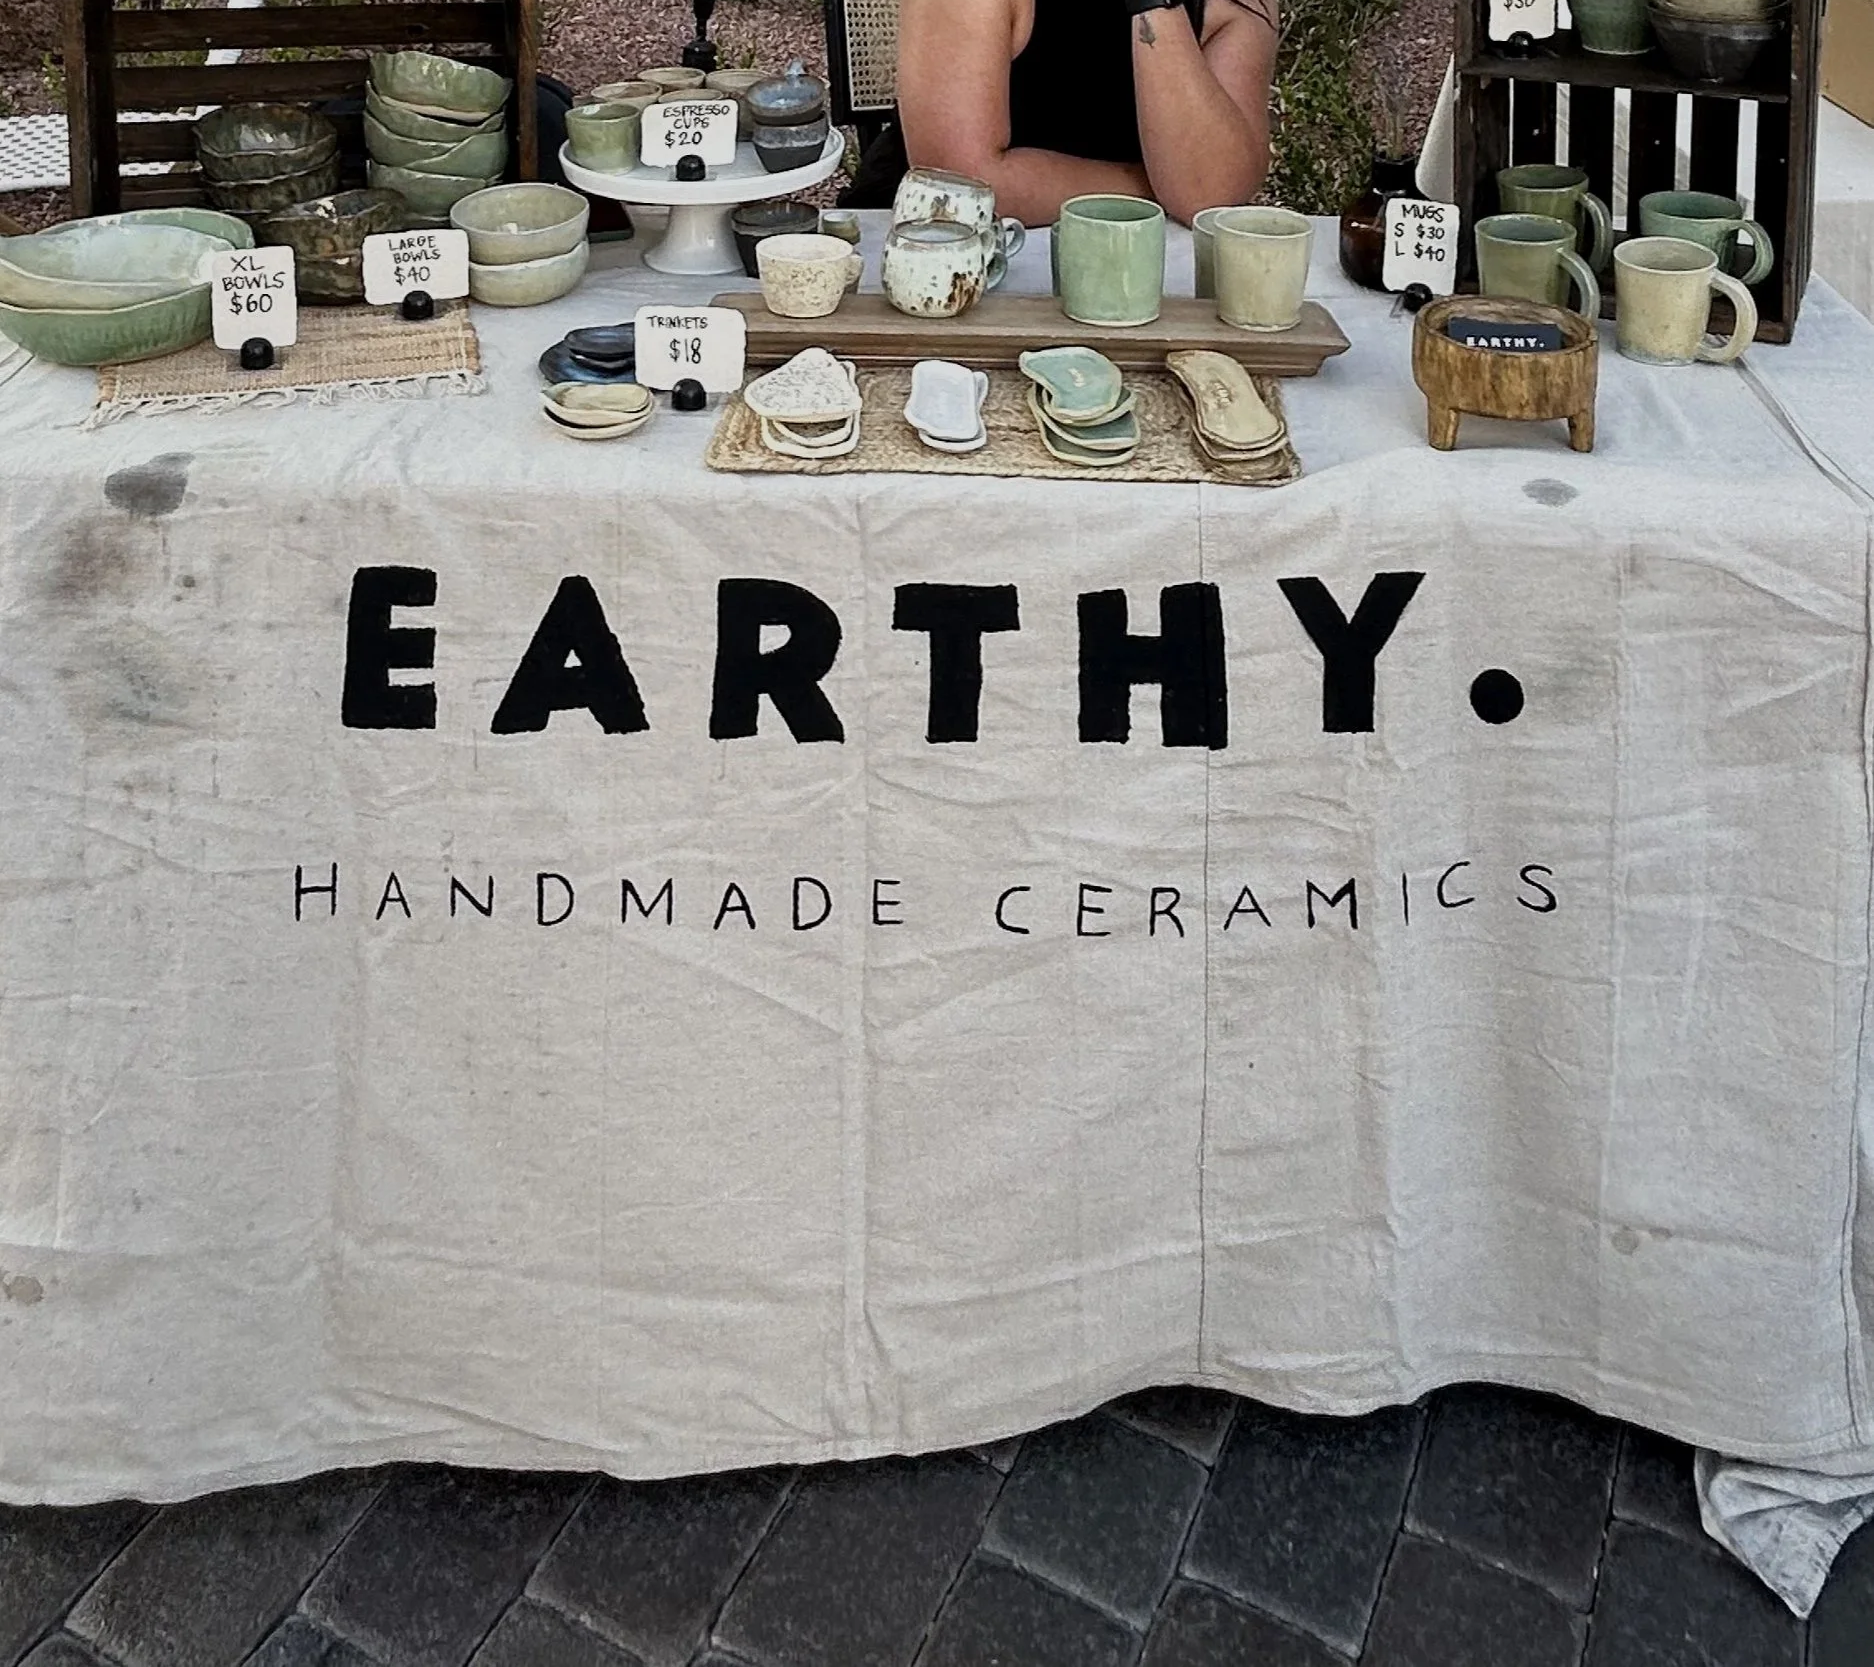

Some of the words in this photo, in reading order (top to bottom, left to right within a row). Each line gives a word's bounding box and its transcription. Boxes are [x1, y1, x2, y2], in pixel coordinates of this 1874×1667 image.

[662, 104, 731, 118] ESPRESSO
[673, 116, 710, 130] CUPS
[664, 130, 703, 149] $20
[1401, 204, 1446, 223] MUGS
[1394, 222, 1406, 238] S
[1416, 224, 1446, 241] $30
[388, 235, 437, 252] LARGE
[1395, 241, 1406, 257] L
[1413, 241, 1446, 262] $40
[230, 256, 266, 272] XL
[392, 249, 442, 265] BOWLS
[222, 271, 287, 292] BOWLS
[393, 266, 432, 286] $40
[228, 292, 274, 316] $60
[668, 337, 703, 365] $18
[1466, 336, 1546, 348] EARTHY.
[341, 565, 1525, 752] EARTHY.
[294, 861, 904, 932] HANDMADE
[994, 860, 1559, 938] CERAMICS
